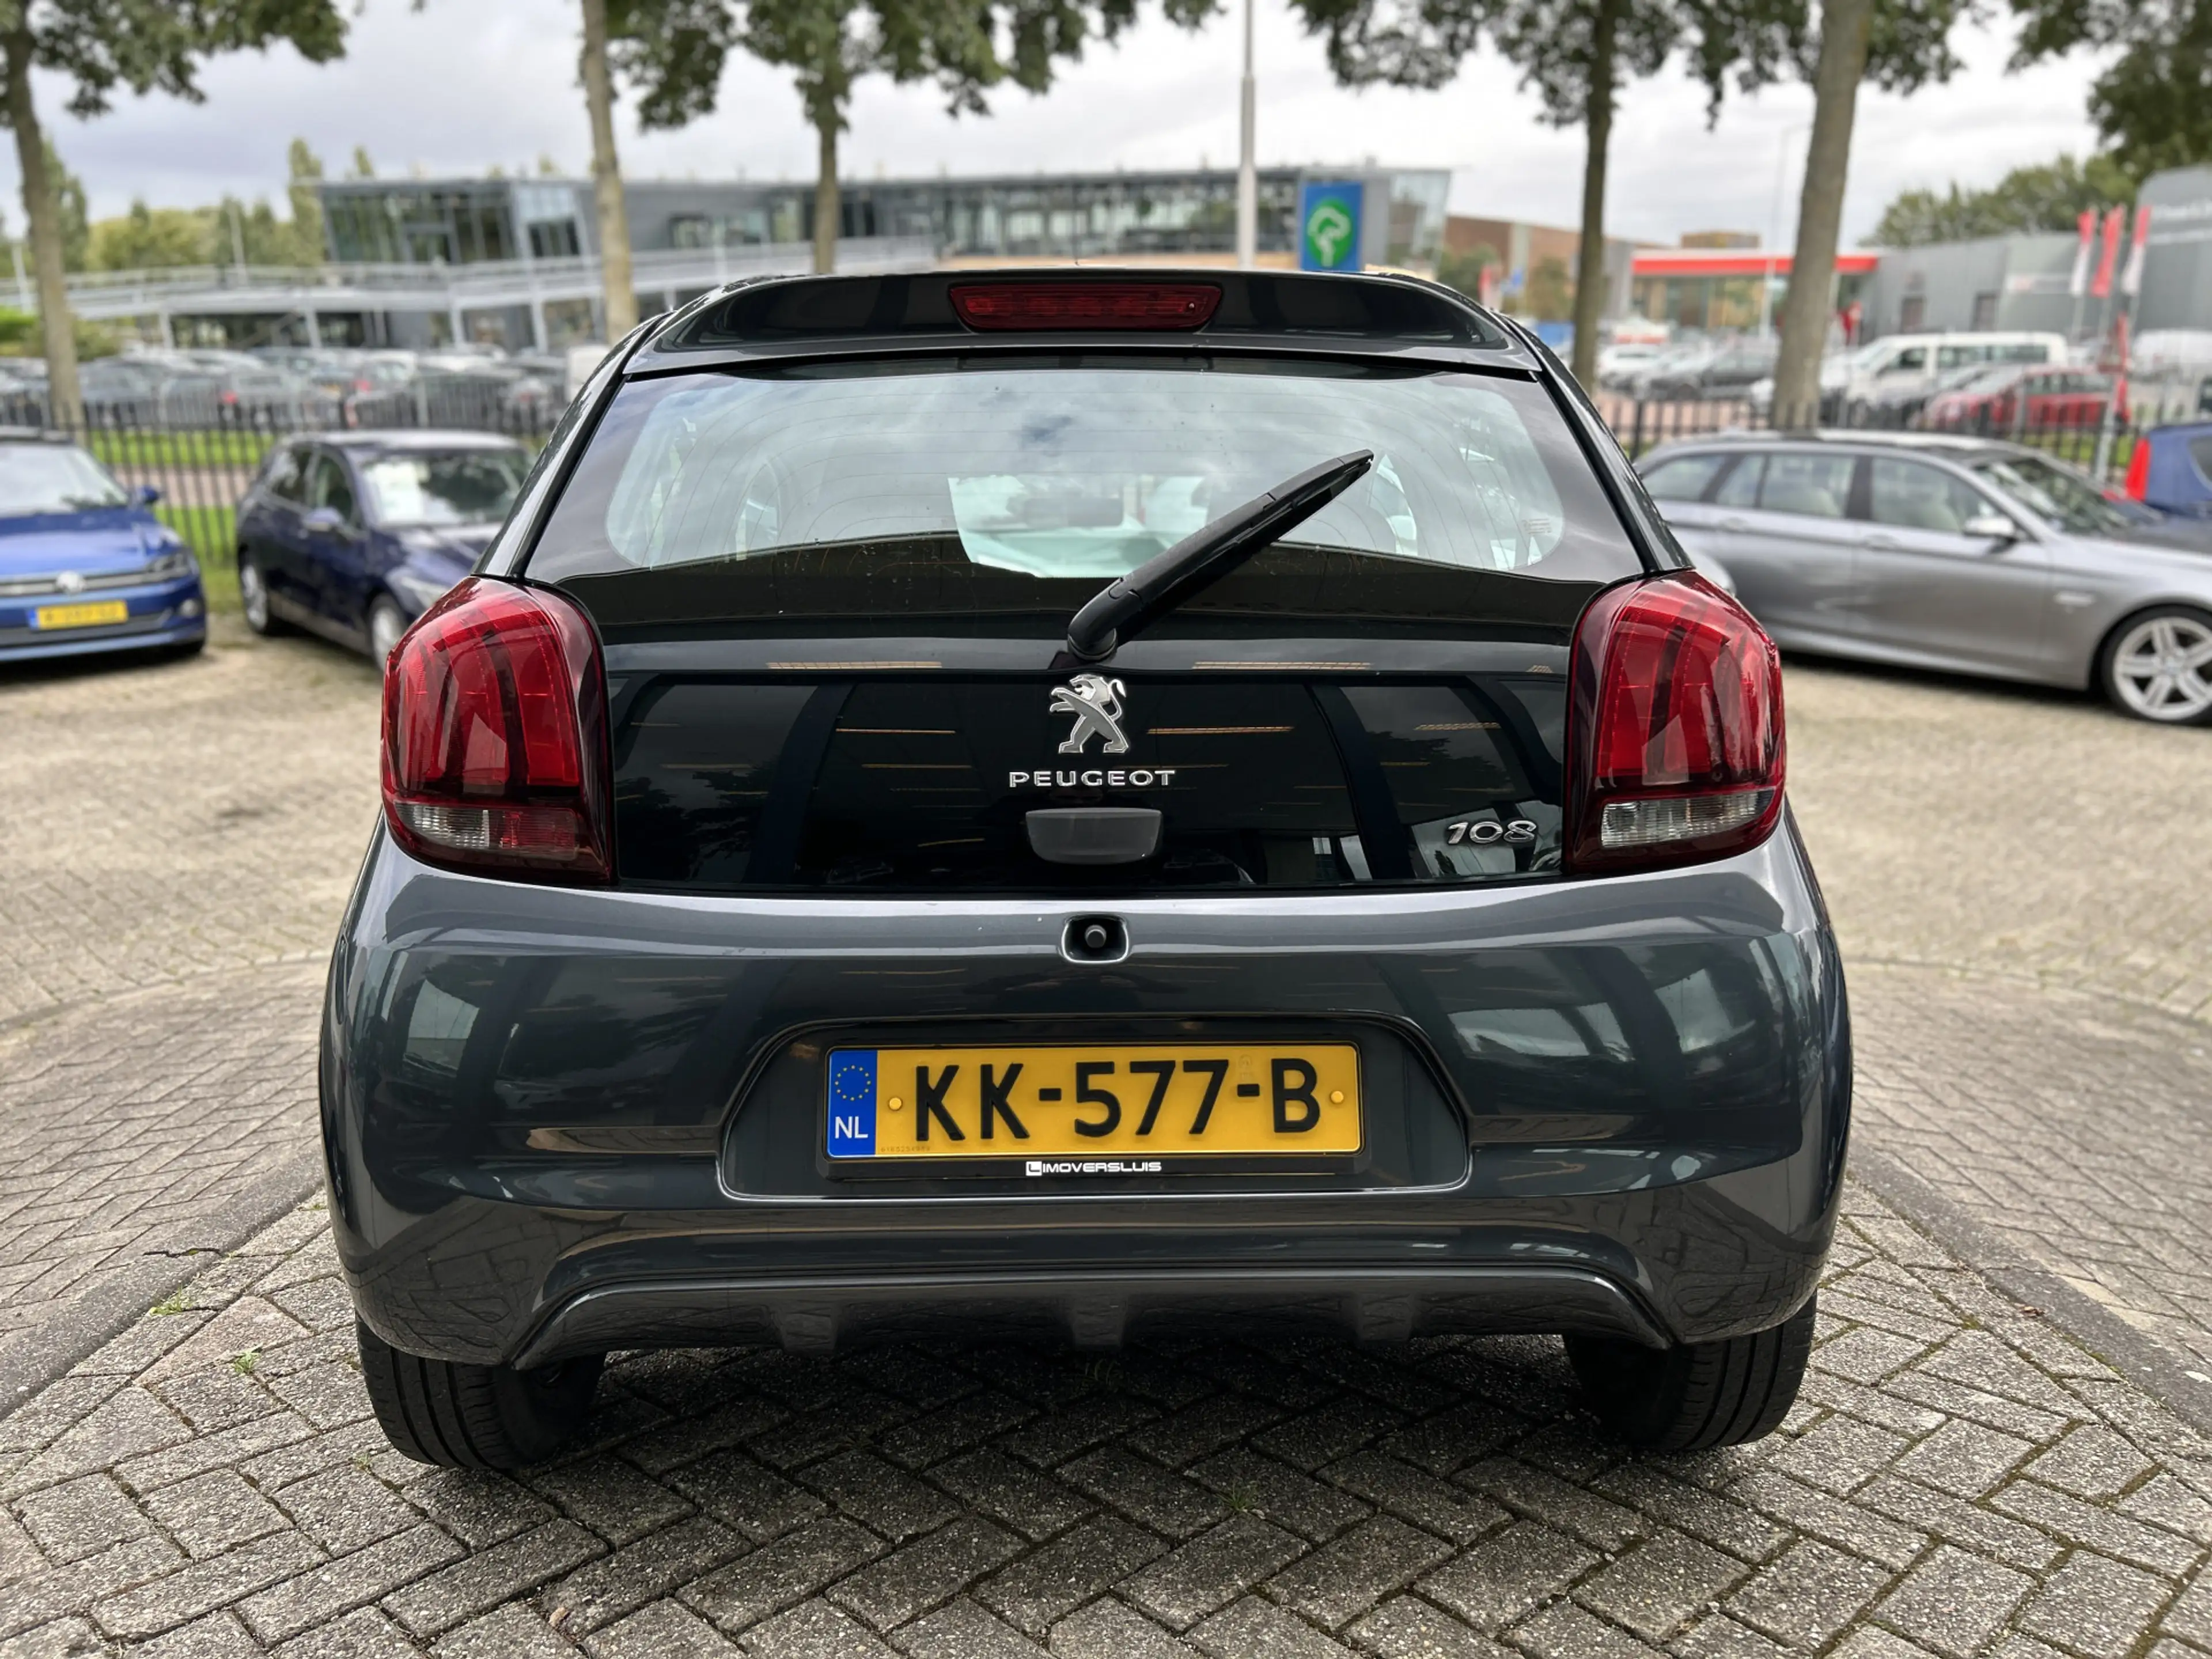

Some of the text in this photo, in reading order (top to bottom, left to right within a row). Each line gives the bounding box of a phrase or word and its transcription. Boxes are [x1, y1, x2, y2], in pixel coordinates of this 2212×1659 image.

[1009, 770, 1175, 787] PEUGEOT
[1448, 820, 1537, 844] 108
[916, 1058, 1320, 1141] KK-577-B
[835, 1116, 868, 1139] NL
